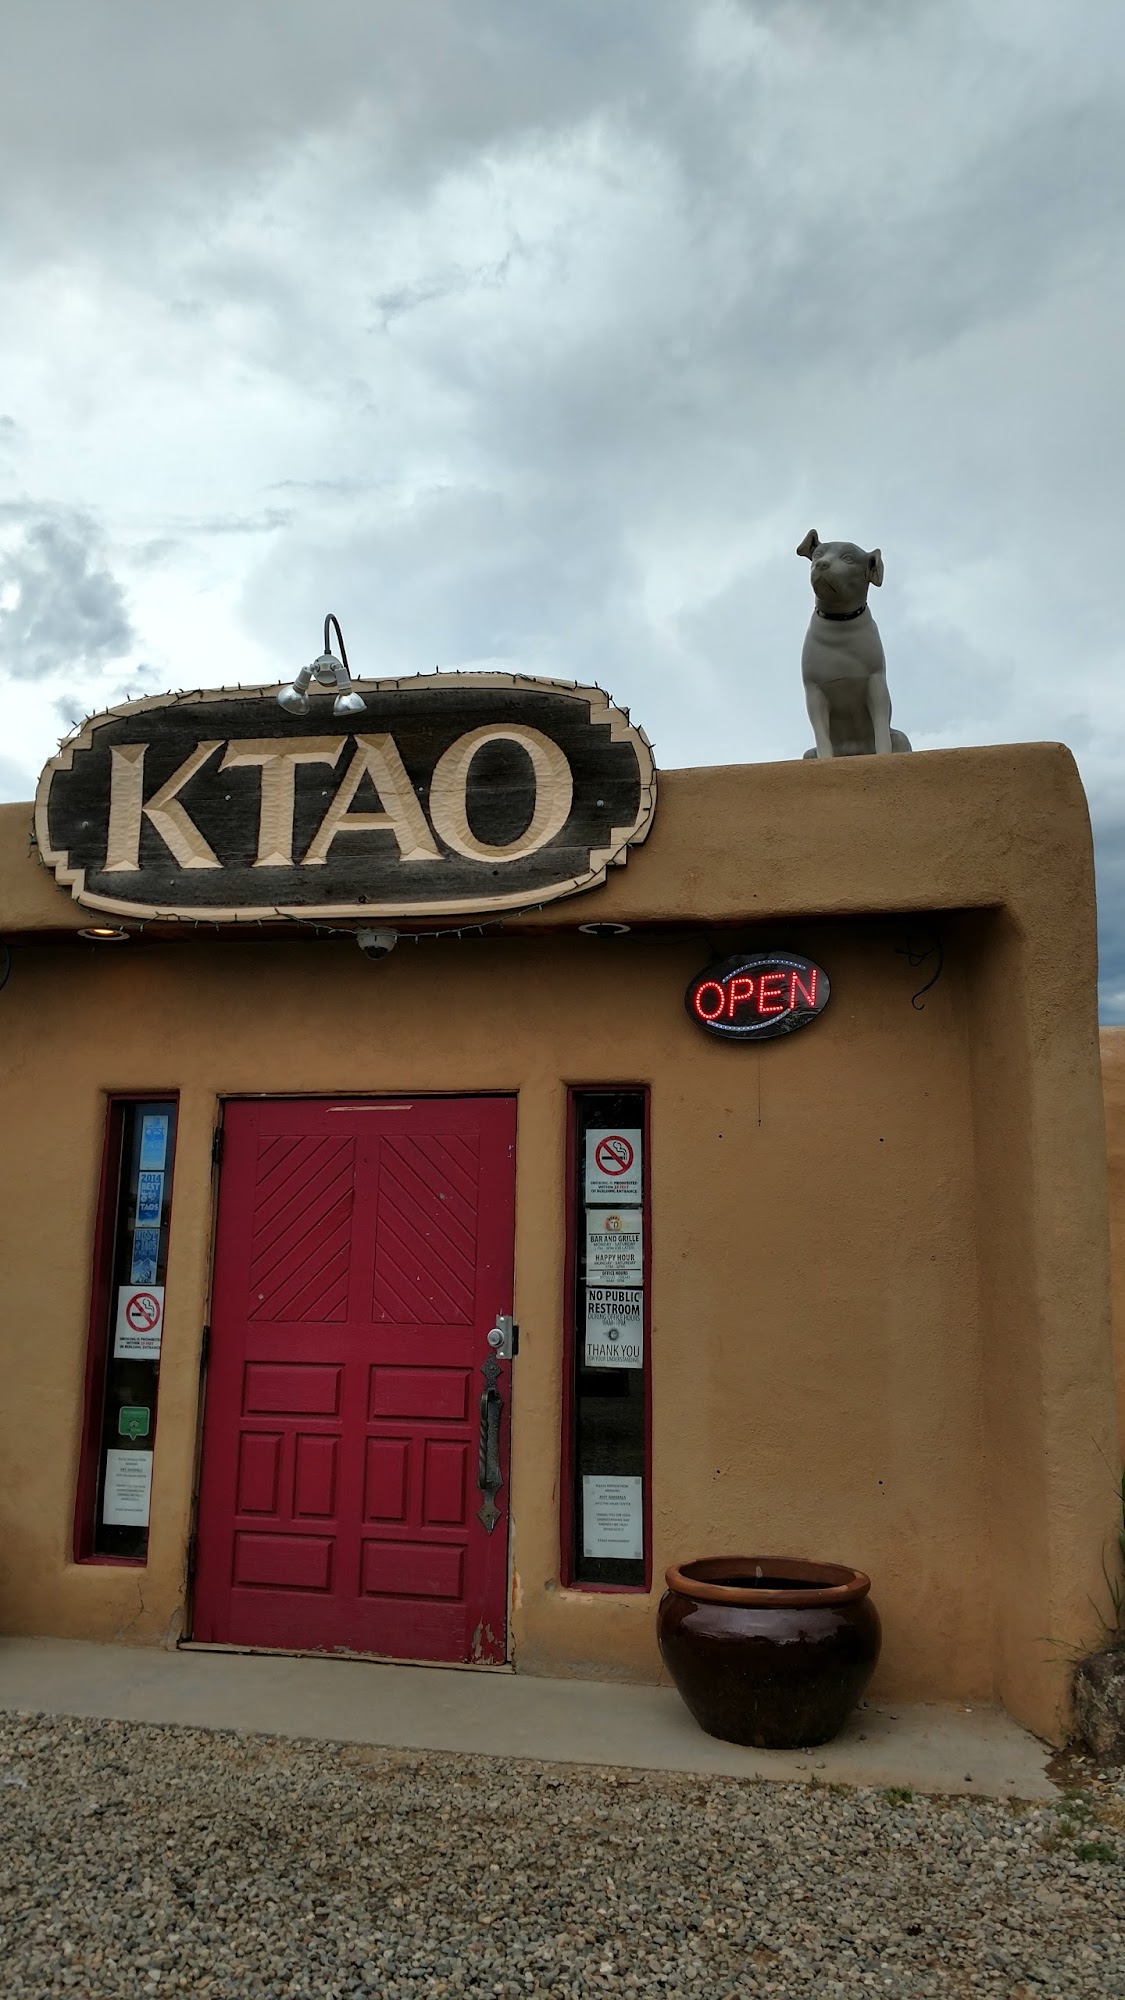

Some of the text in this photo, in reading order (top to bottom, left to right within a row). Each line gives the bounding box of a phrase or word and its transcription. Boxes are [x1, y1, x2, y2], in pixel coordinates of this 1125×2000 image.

[102, 722, 574, 871] KTAO
[695, 968, 818, 1020] OPEN
[141, 1183, 160, 1191] BEST
[140, 1203, 158, 1211] TAOS
[589, 1290, 640, 1302] NO PUBLIC
[588, 1303, 640, 1315] RESTROOM
[587, 1344, 640, 1357] THANK YOU
